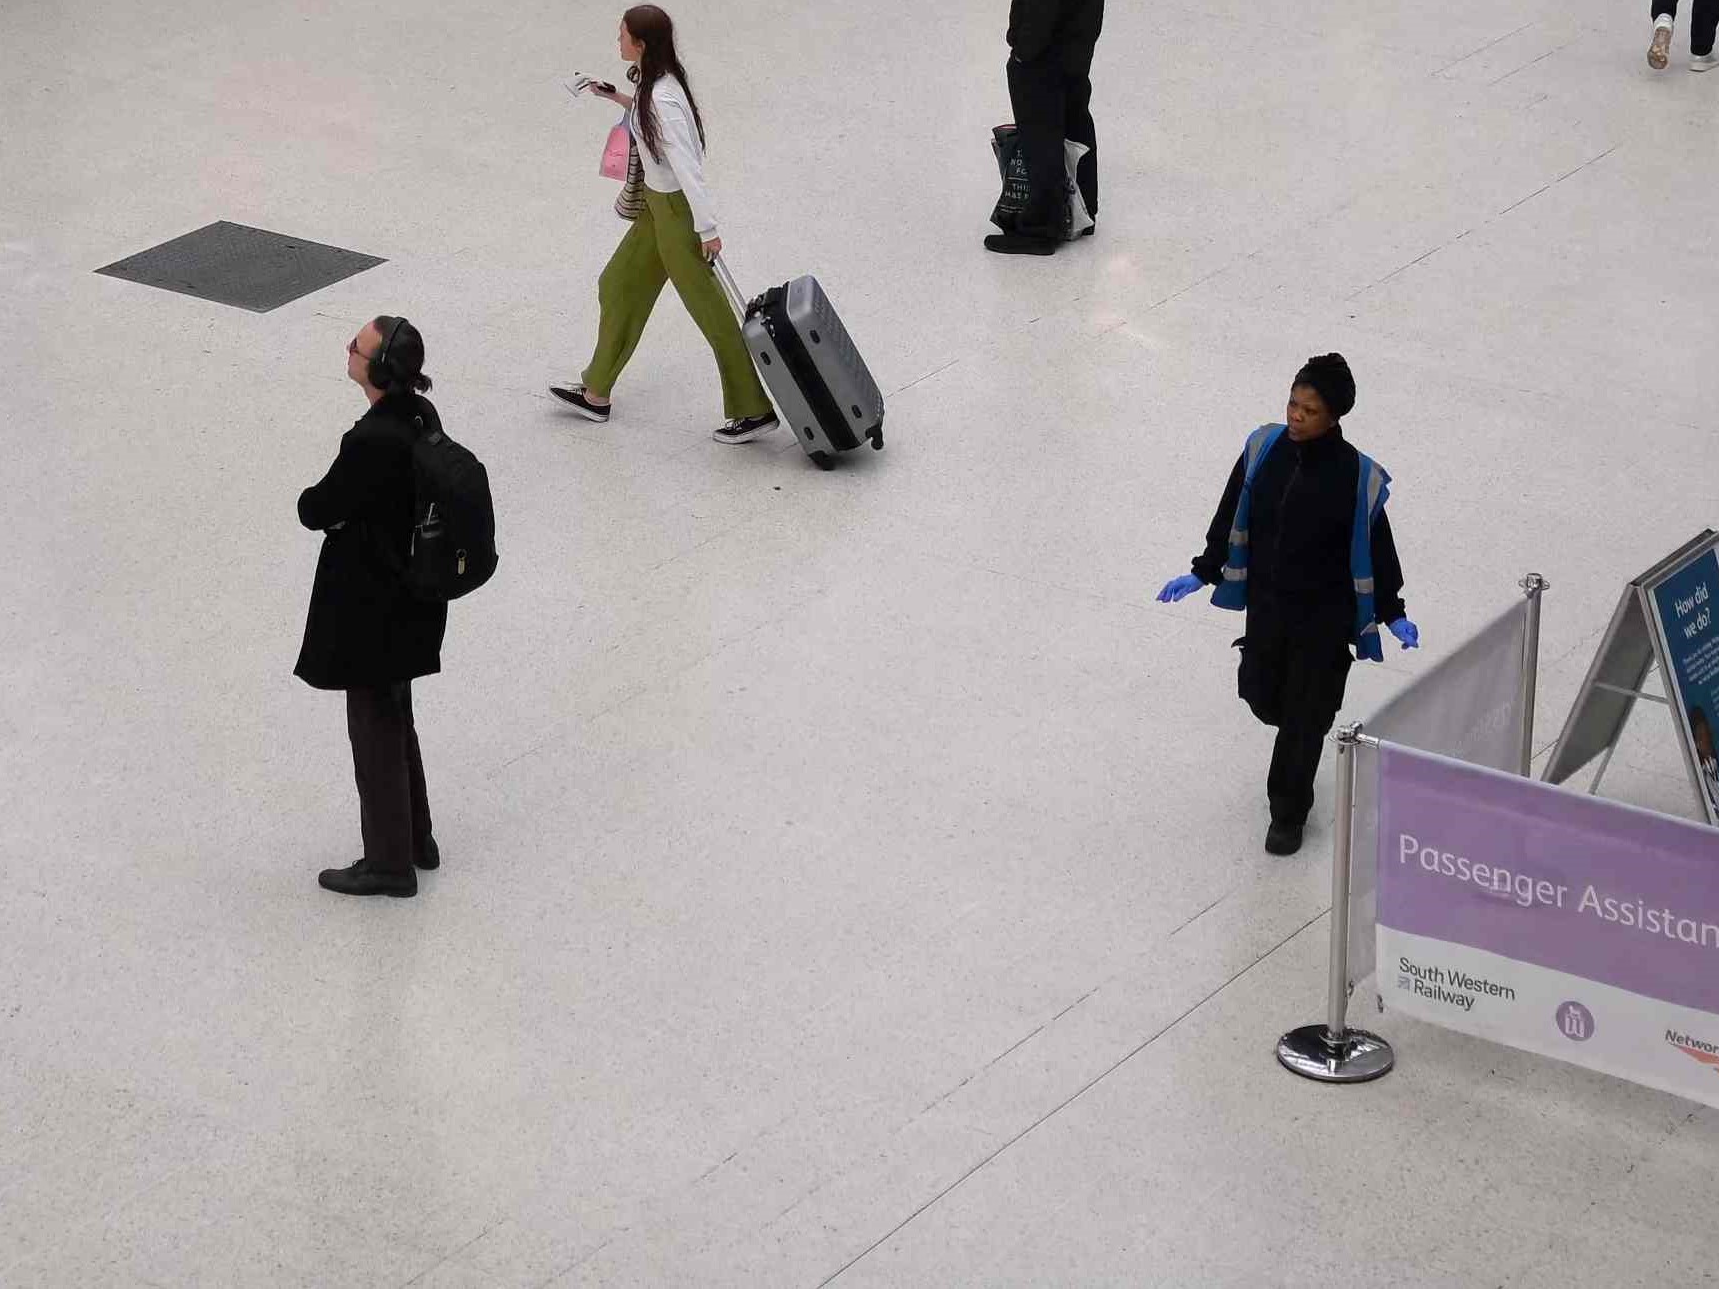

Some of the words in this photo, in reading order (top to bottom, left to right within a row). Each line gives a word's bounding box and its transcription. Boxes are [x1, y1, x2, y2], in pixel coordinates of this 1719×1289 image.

[1674, 597, 1695, 620] How
[1694, 581, 1709, 605] did
[1683, 623, 1697, 639] we
[1696, 607, 1712, 632] do?
[1398, 833, 1568, 908] Passenger
[1398, 956, 1445, 984] South
[1447, 969, 1516, 1001] Western
[1413, 978, 1475, 1012] Railway
